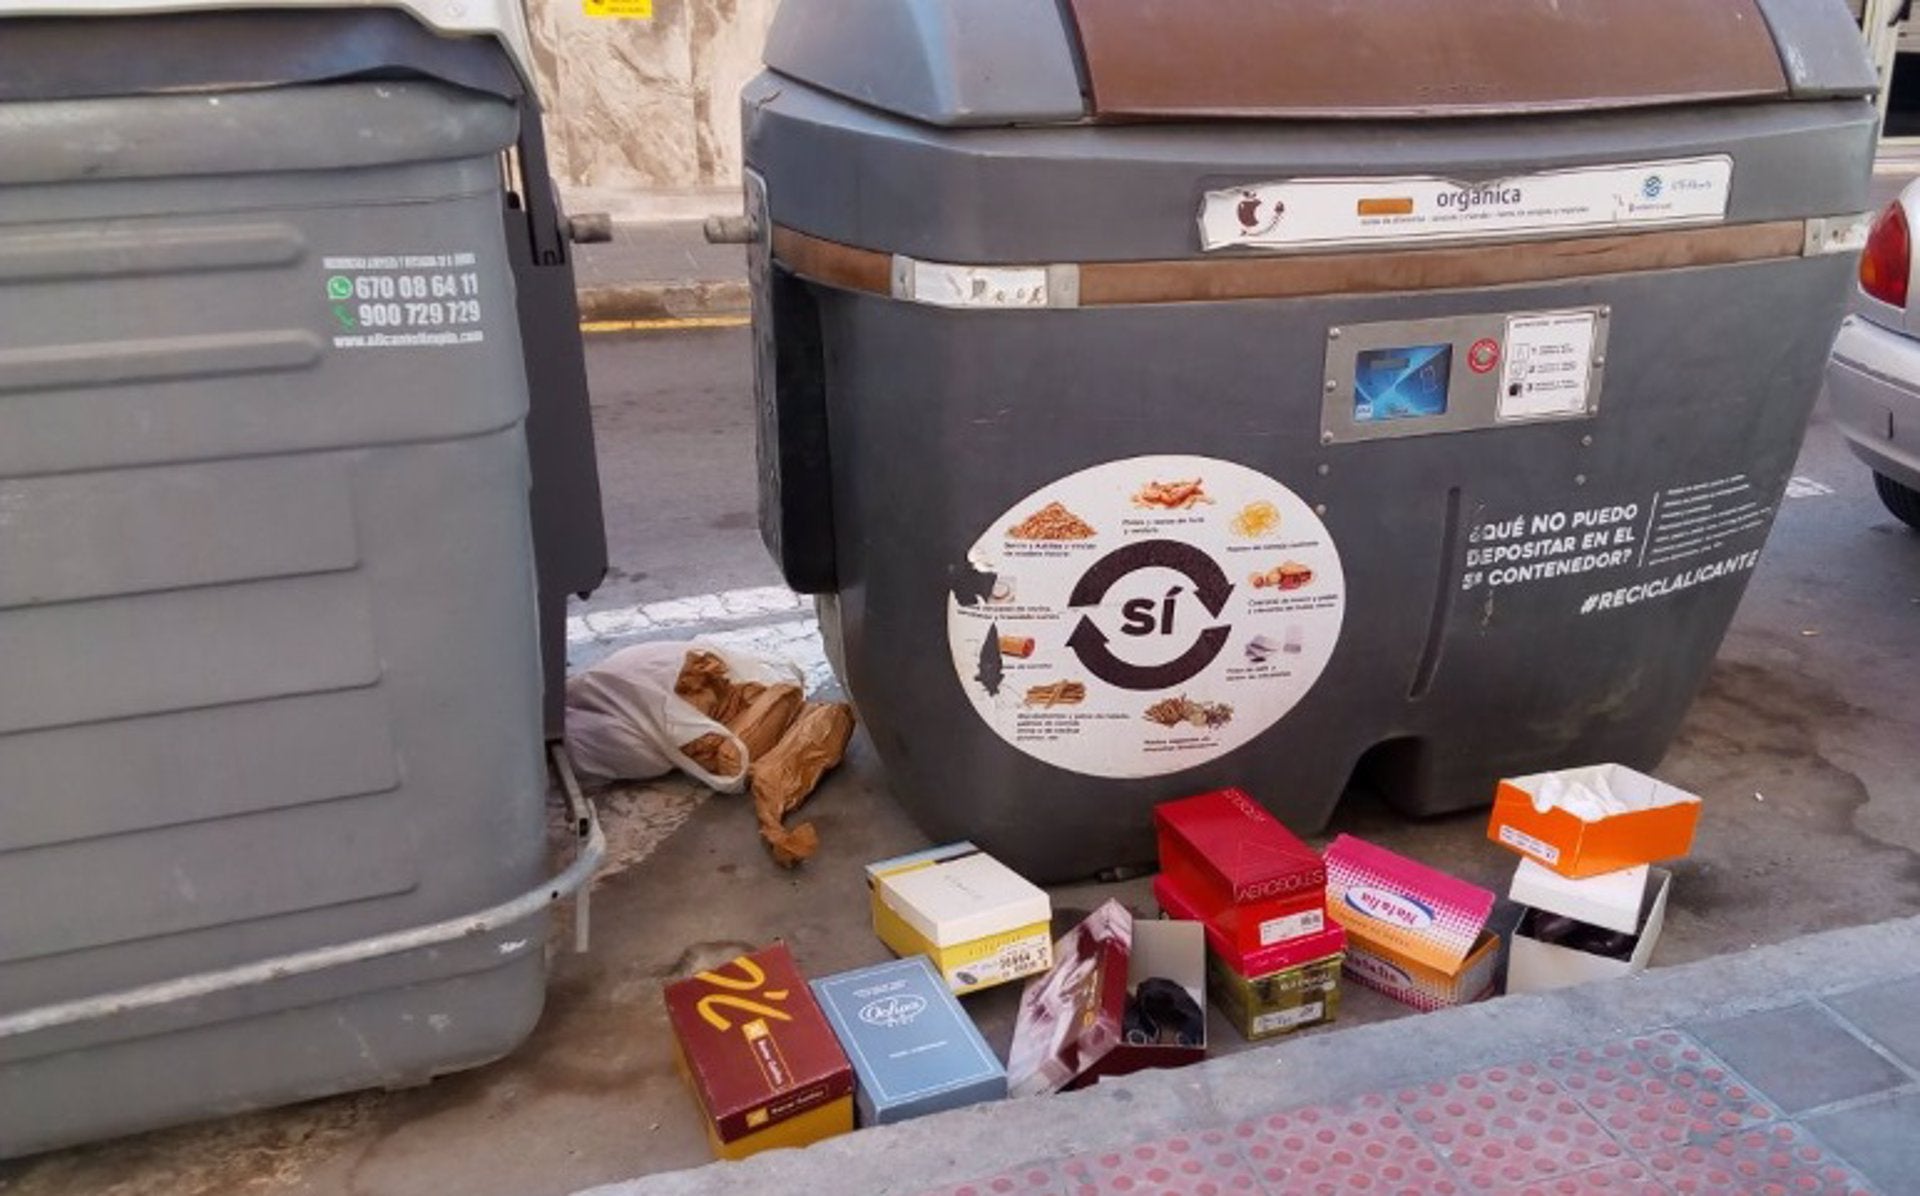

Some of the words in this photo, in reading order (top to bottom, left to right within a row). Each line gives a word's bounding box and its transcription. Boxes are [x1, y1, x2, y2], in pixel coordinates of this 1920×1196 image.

[355, 276, 394, 299] 670
[398, 275, 427, 298] 08
[431, 274, 457, 297] 64
[460, 272, 478, 294] 11
[359, 303, 400, 327] 900
[404, 303, 443, 325] 729
[445, 299, 480, 324] 729
[1469, 514, 1526, 543] ¿QUÉ
[1531, 511, 1565, 535] NO
[1572, 503, 1638, 529] PUEDO
[1466, 536, 1576, 567] DEPOSITAR
[1581, 530, 1610, 549] EN
[1613, 526, 1636, 544] EL
[1488, 548, 1633, 586] CONTENEDOR?
[1580, 549, 1760, 614] #RECICLALICANTE
